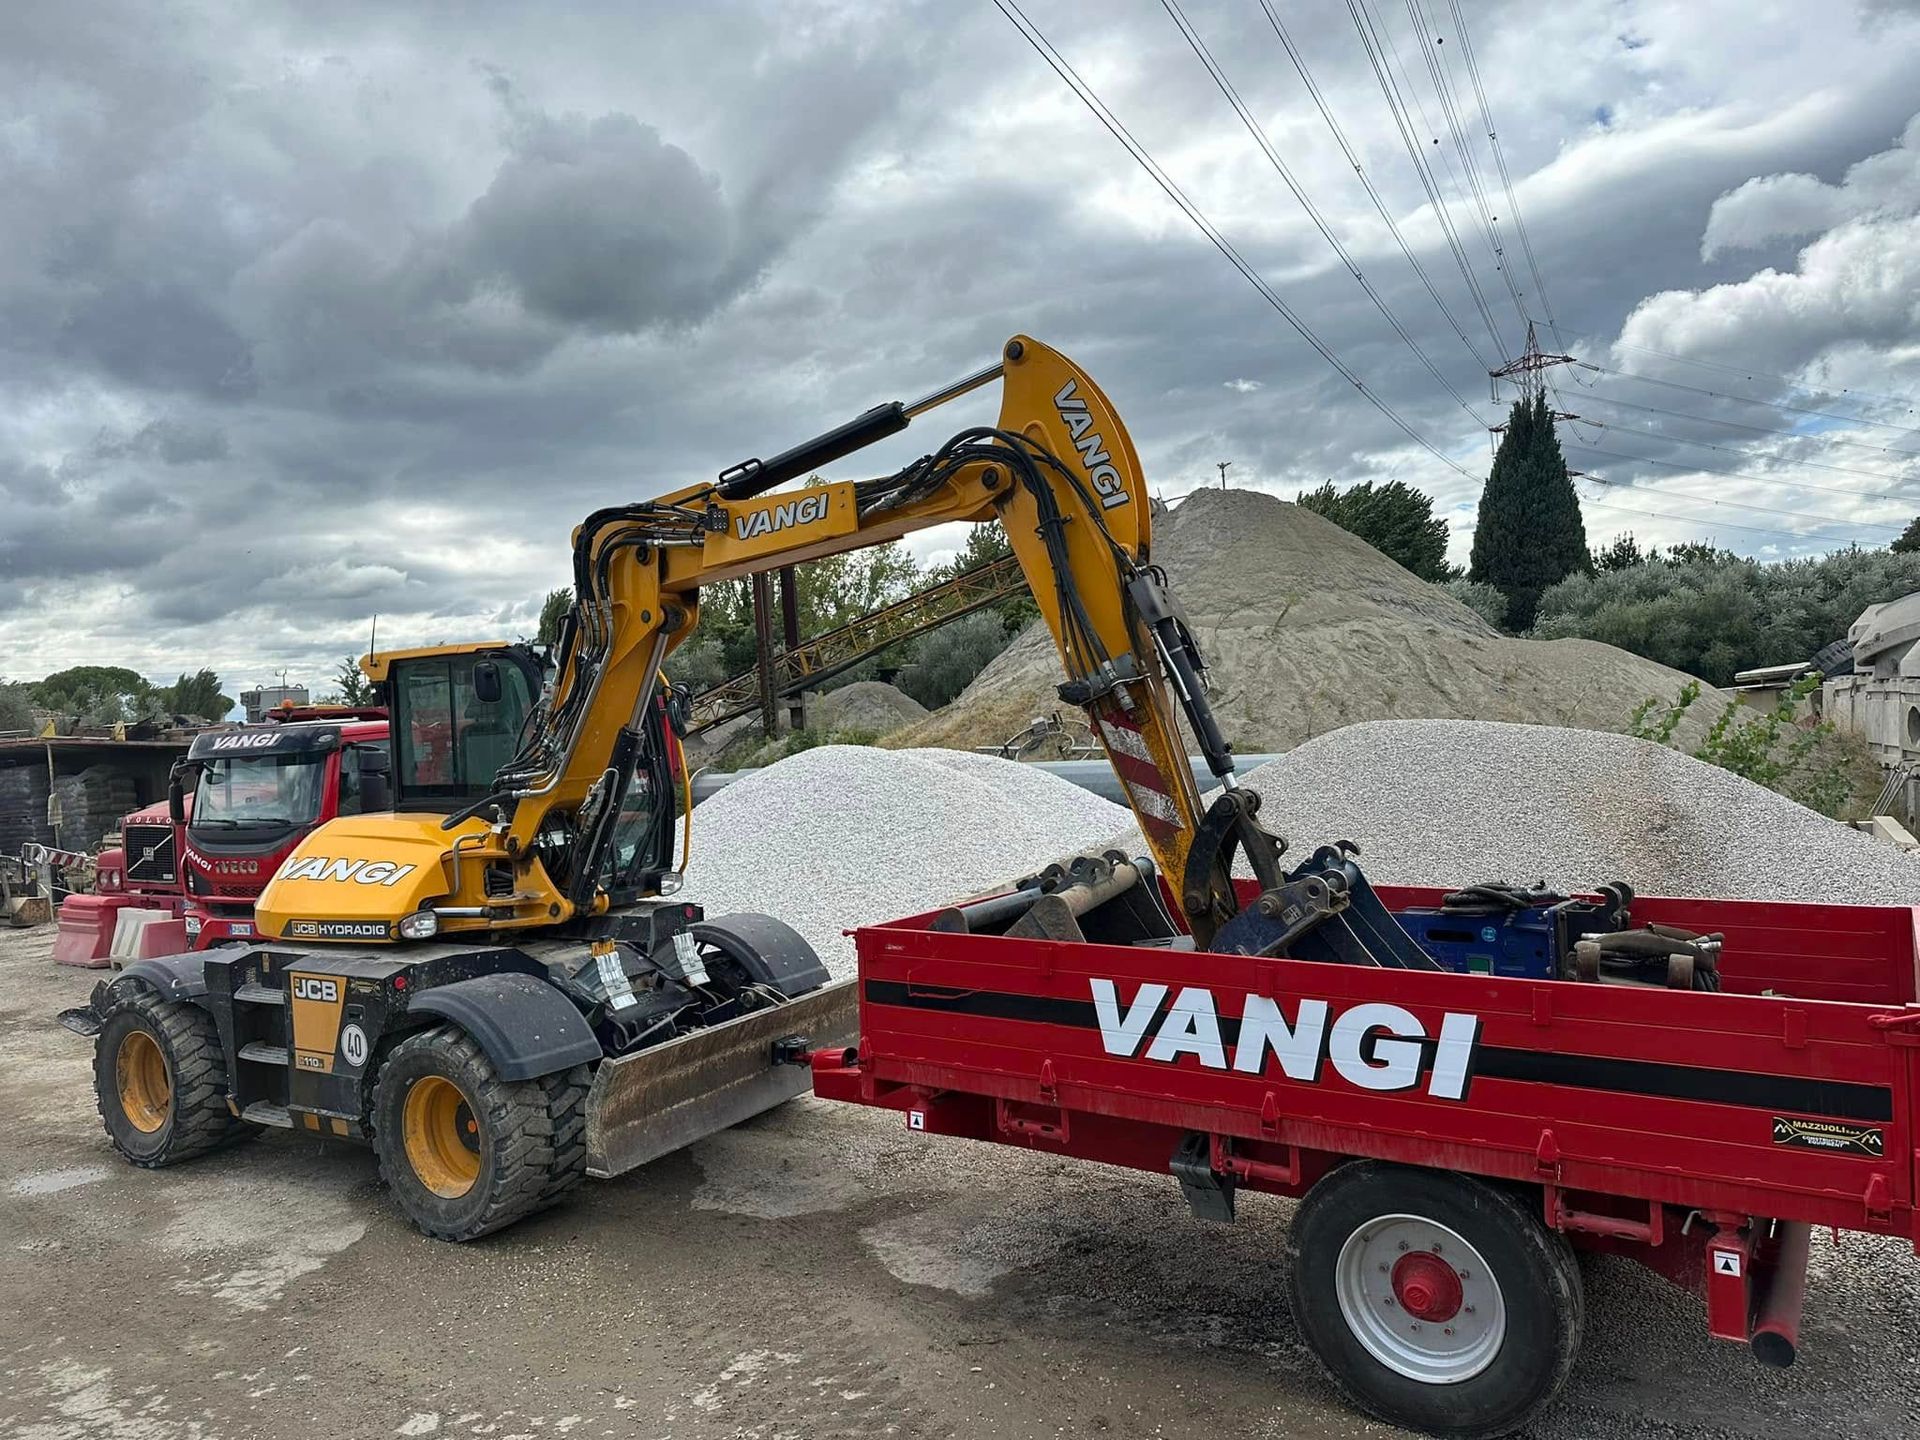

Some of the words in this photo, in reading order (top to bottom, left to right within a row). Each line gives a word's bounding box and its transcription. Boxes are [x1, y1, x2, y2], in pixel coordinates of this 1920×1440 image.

[1054, 379, 1130, 509] VANGI
[735, 492, 830, 541] VANGI
[212, 733, 281, 750] VANGI
[126, 816, 172, 824] VOLVO
[186, 847, 212, 871] VANGI
[215, 860, 258, 874] IVECO
[278, 857, 418, 886] VANGI
[293, 923, 316, 934] JCB
[318, 925, 386, 935] HYDRADIG
[295, 979, 338, 1001] JCB
[347, 1032, 362, 1057] 40
[1089, 977, 1478, 1101] VANGI
[1792, 1120, 1845, 1133] MAZZUOLI
